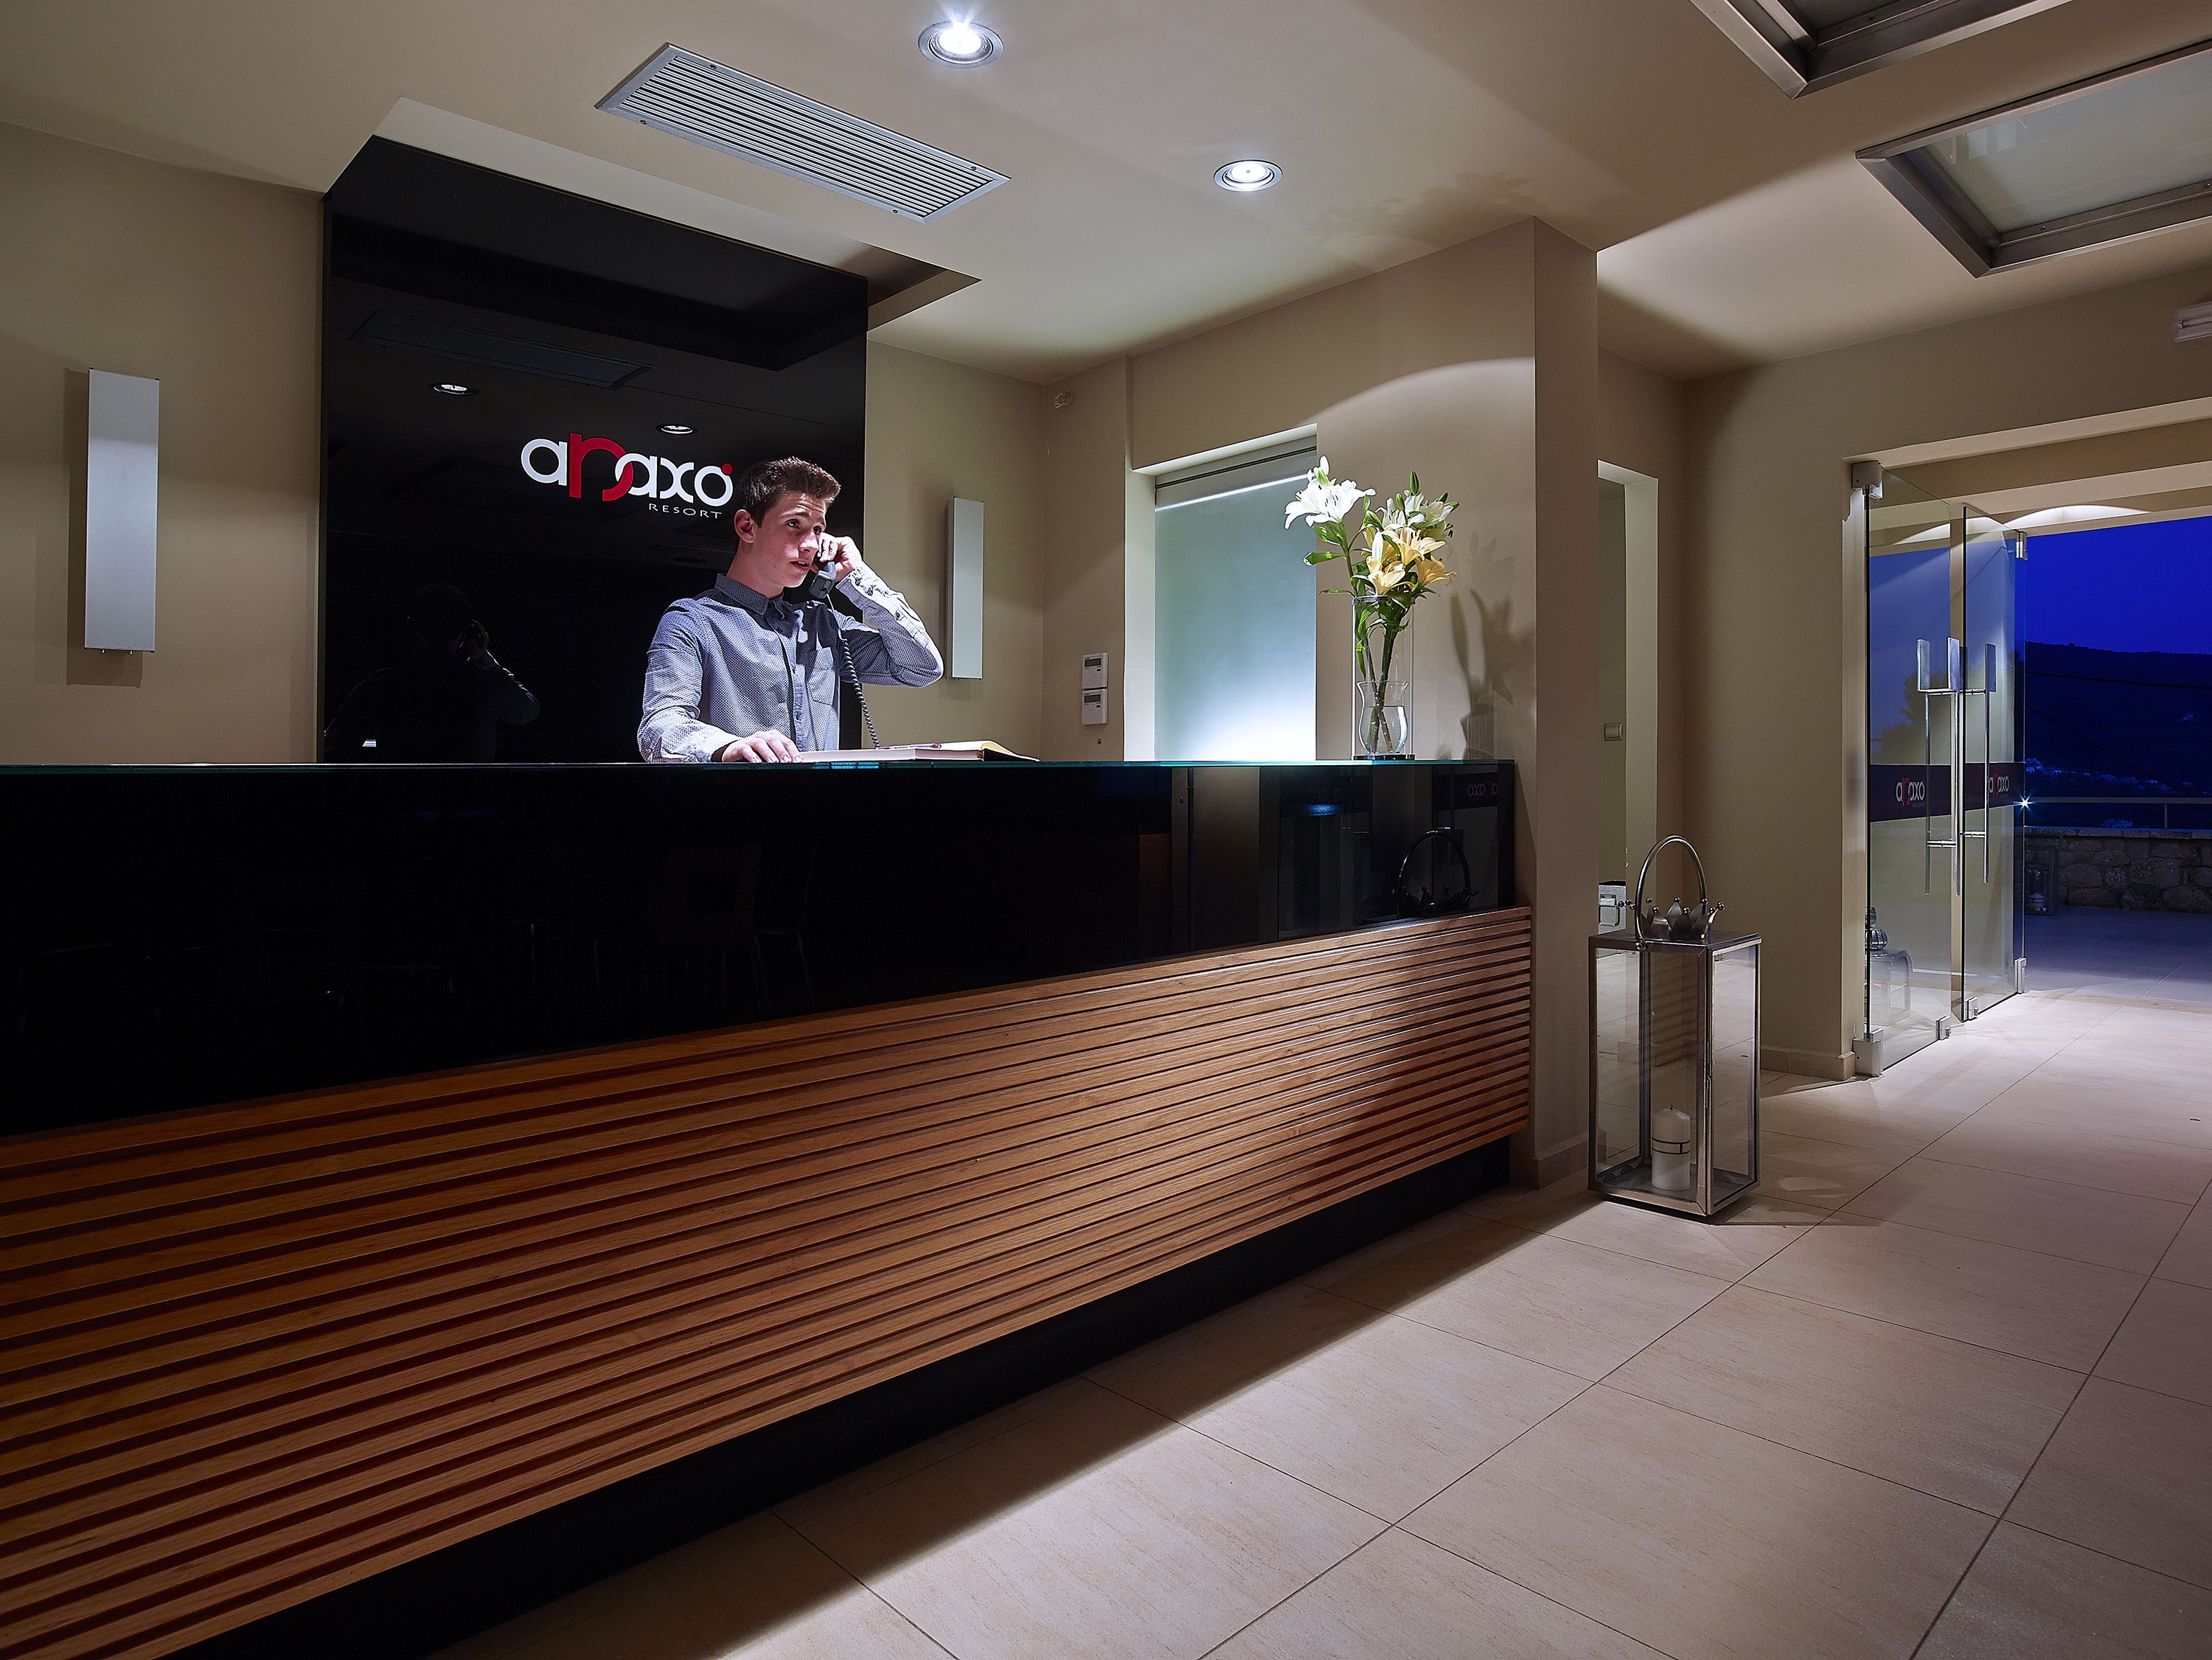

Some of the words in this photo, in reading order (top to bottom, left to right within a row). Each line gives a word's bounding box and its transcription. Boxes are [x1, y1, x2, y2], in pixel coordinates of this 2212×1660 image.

[521, 433, 733, 506] anaxo
[648, 503, 722, 518] RESORT
[1896, 777, 1926, 806] anaxo
